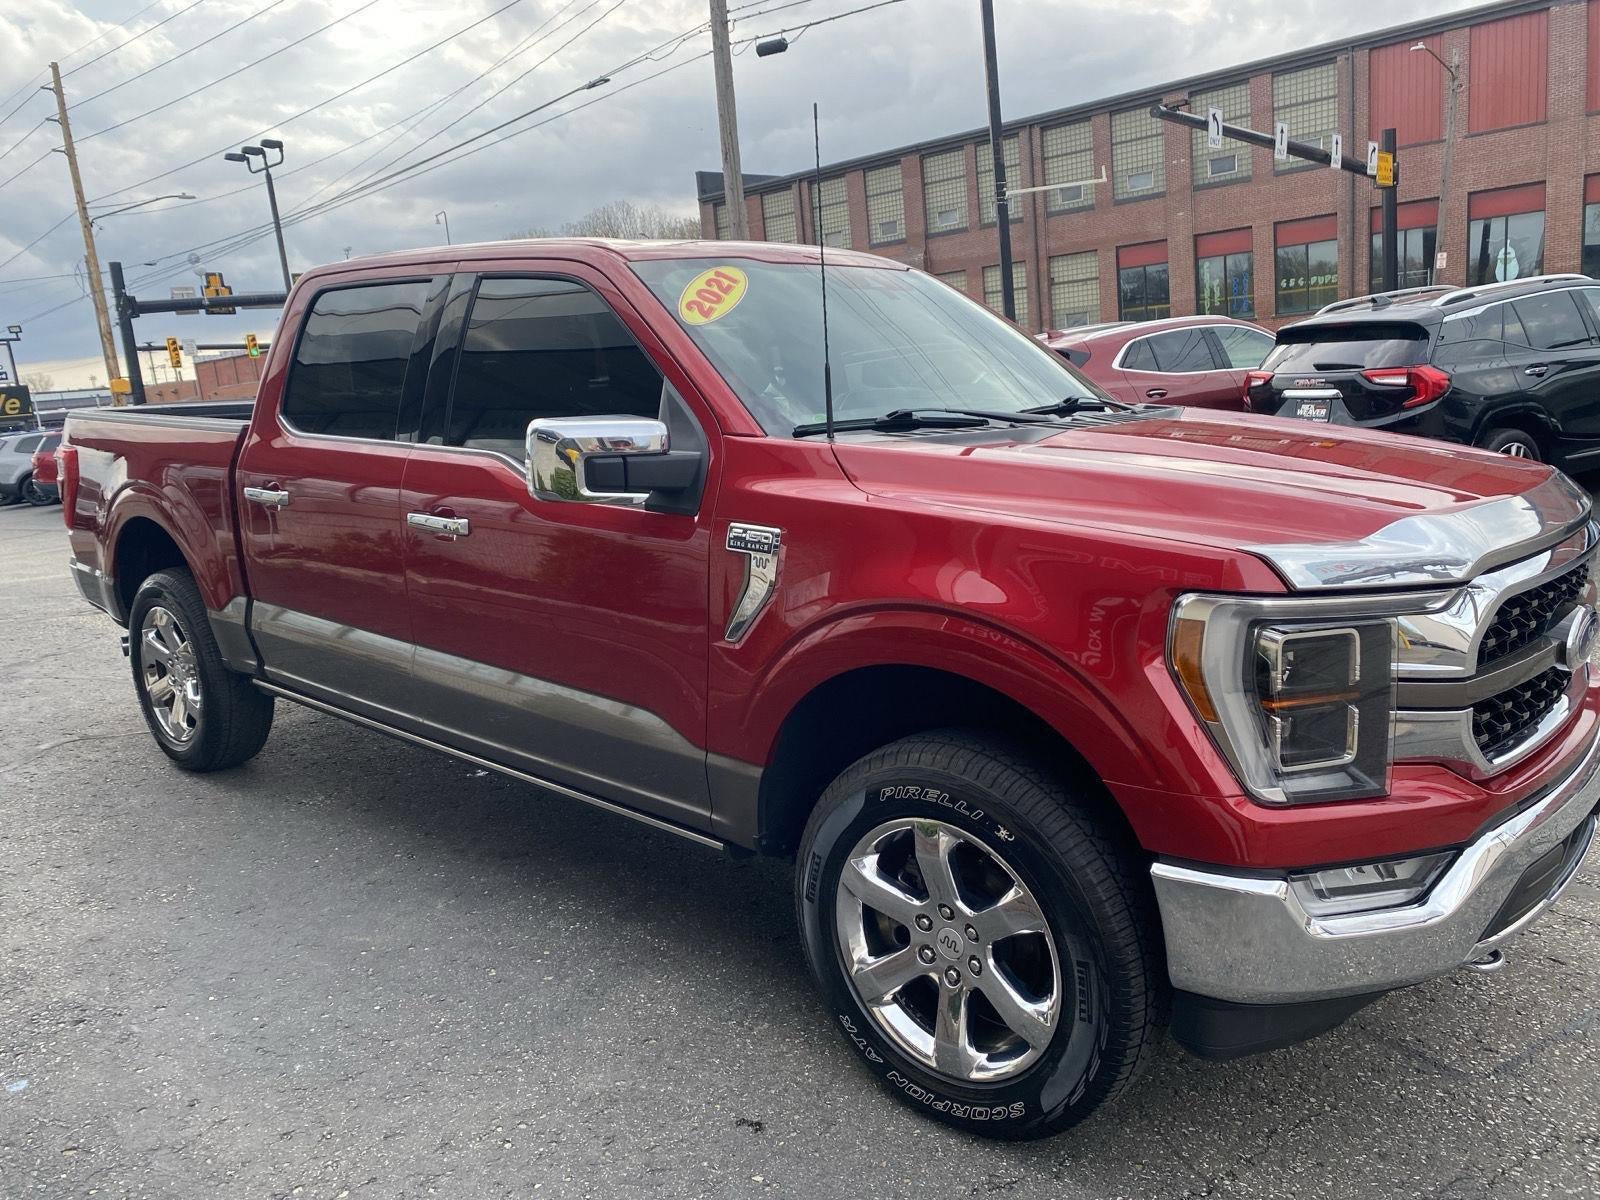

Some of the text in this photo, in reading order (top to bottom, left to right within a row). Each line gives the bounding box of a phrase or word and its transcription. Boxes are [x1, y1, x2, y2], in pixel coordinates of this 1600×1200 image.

[685, 270, 737, 319] 2021
[1294, 378, 1325, 387] GMC
[1297, 408, 1326, 418] WEAVER
[730, 529, 772, 543] F-150
[730, 540, 769, 551] KING RANCH
[880, 786, 984, 820] PIRELLI
[839, 1015, 1025, 1120] SCORPION ATR
